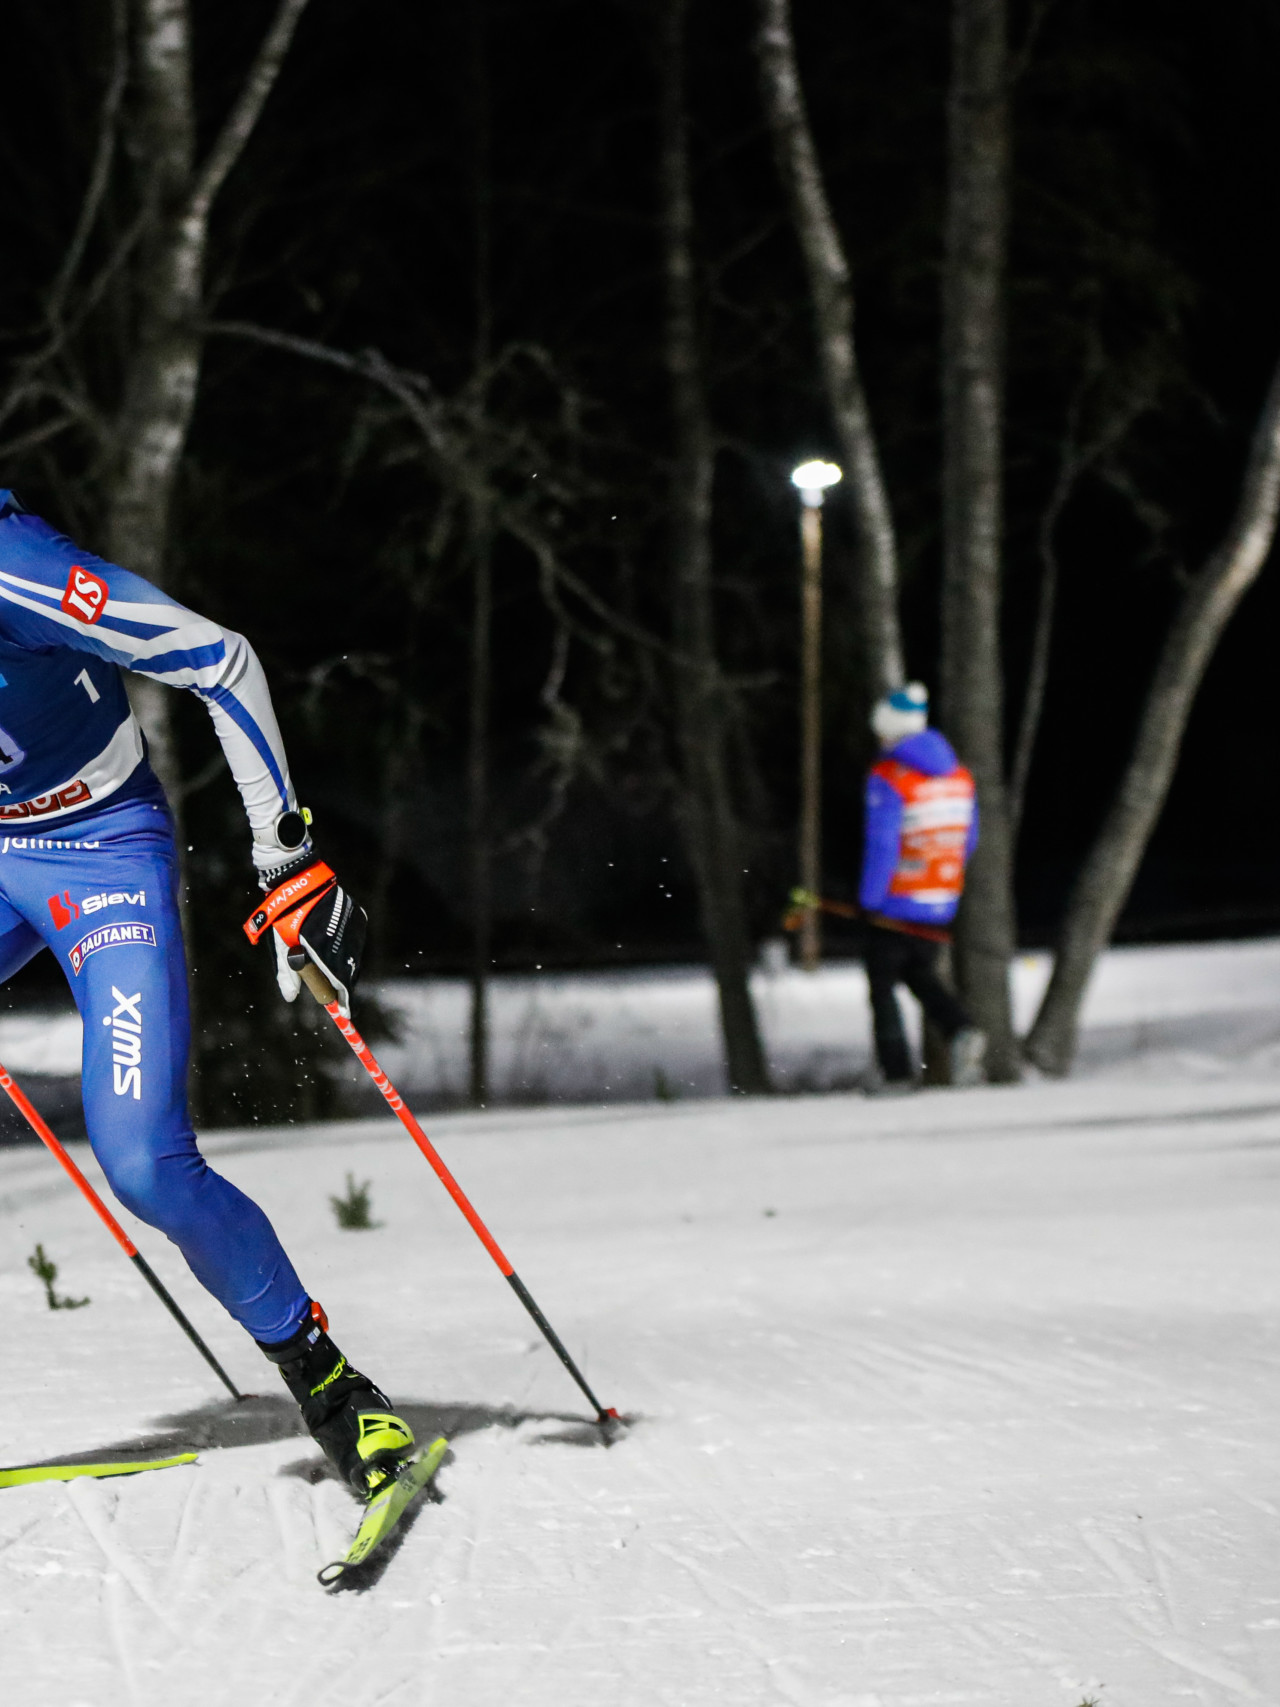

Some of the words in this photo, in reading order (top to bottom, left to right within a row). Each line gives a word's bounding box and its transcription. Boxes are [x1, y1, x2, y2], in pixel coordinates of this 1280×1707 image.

[73, 668, 100, 704] 1
[81, 890, 146, 915] Sievi
[80, 925, 149, 958] RAUTANET
